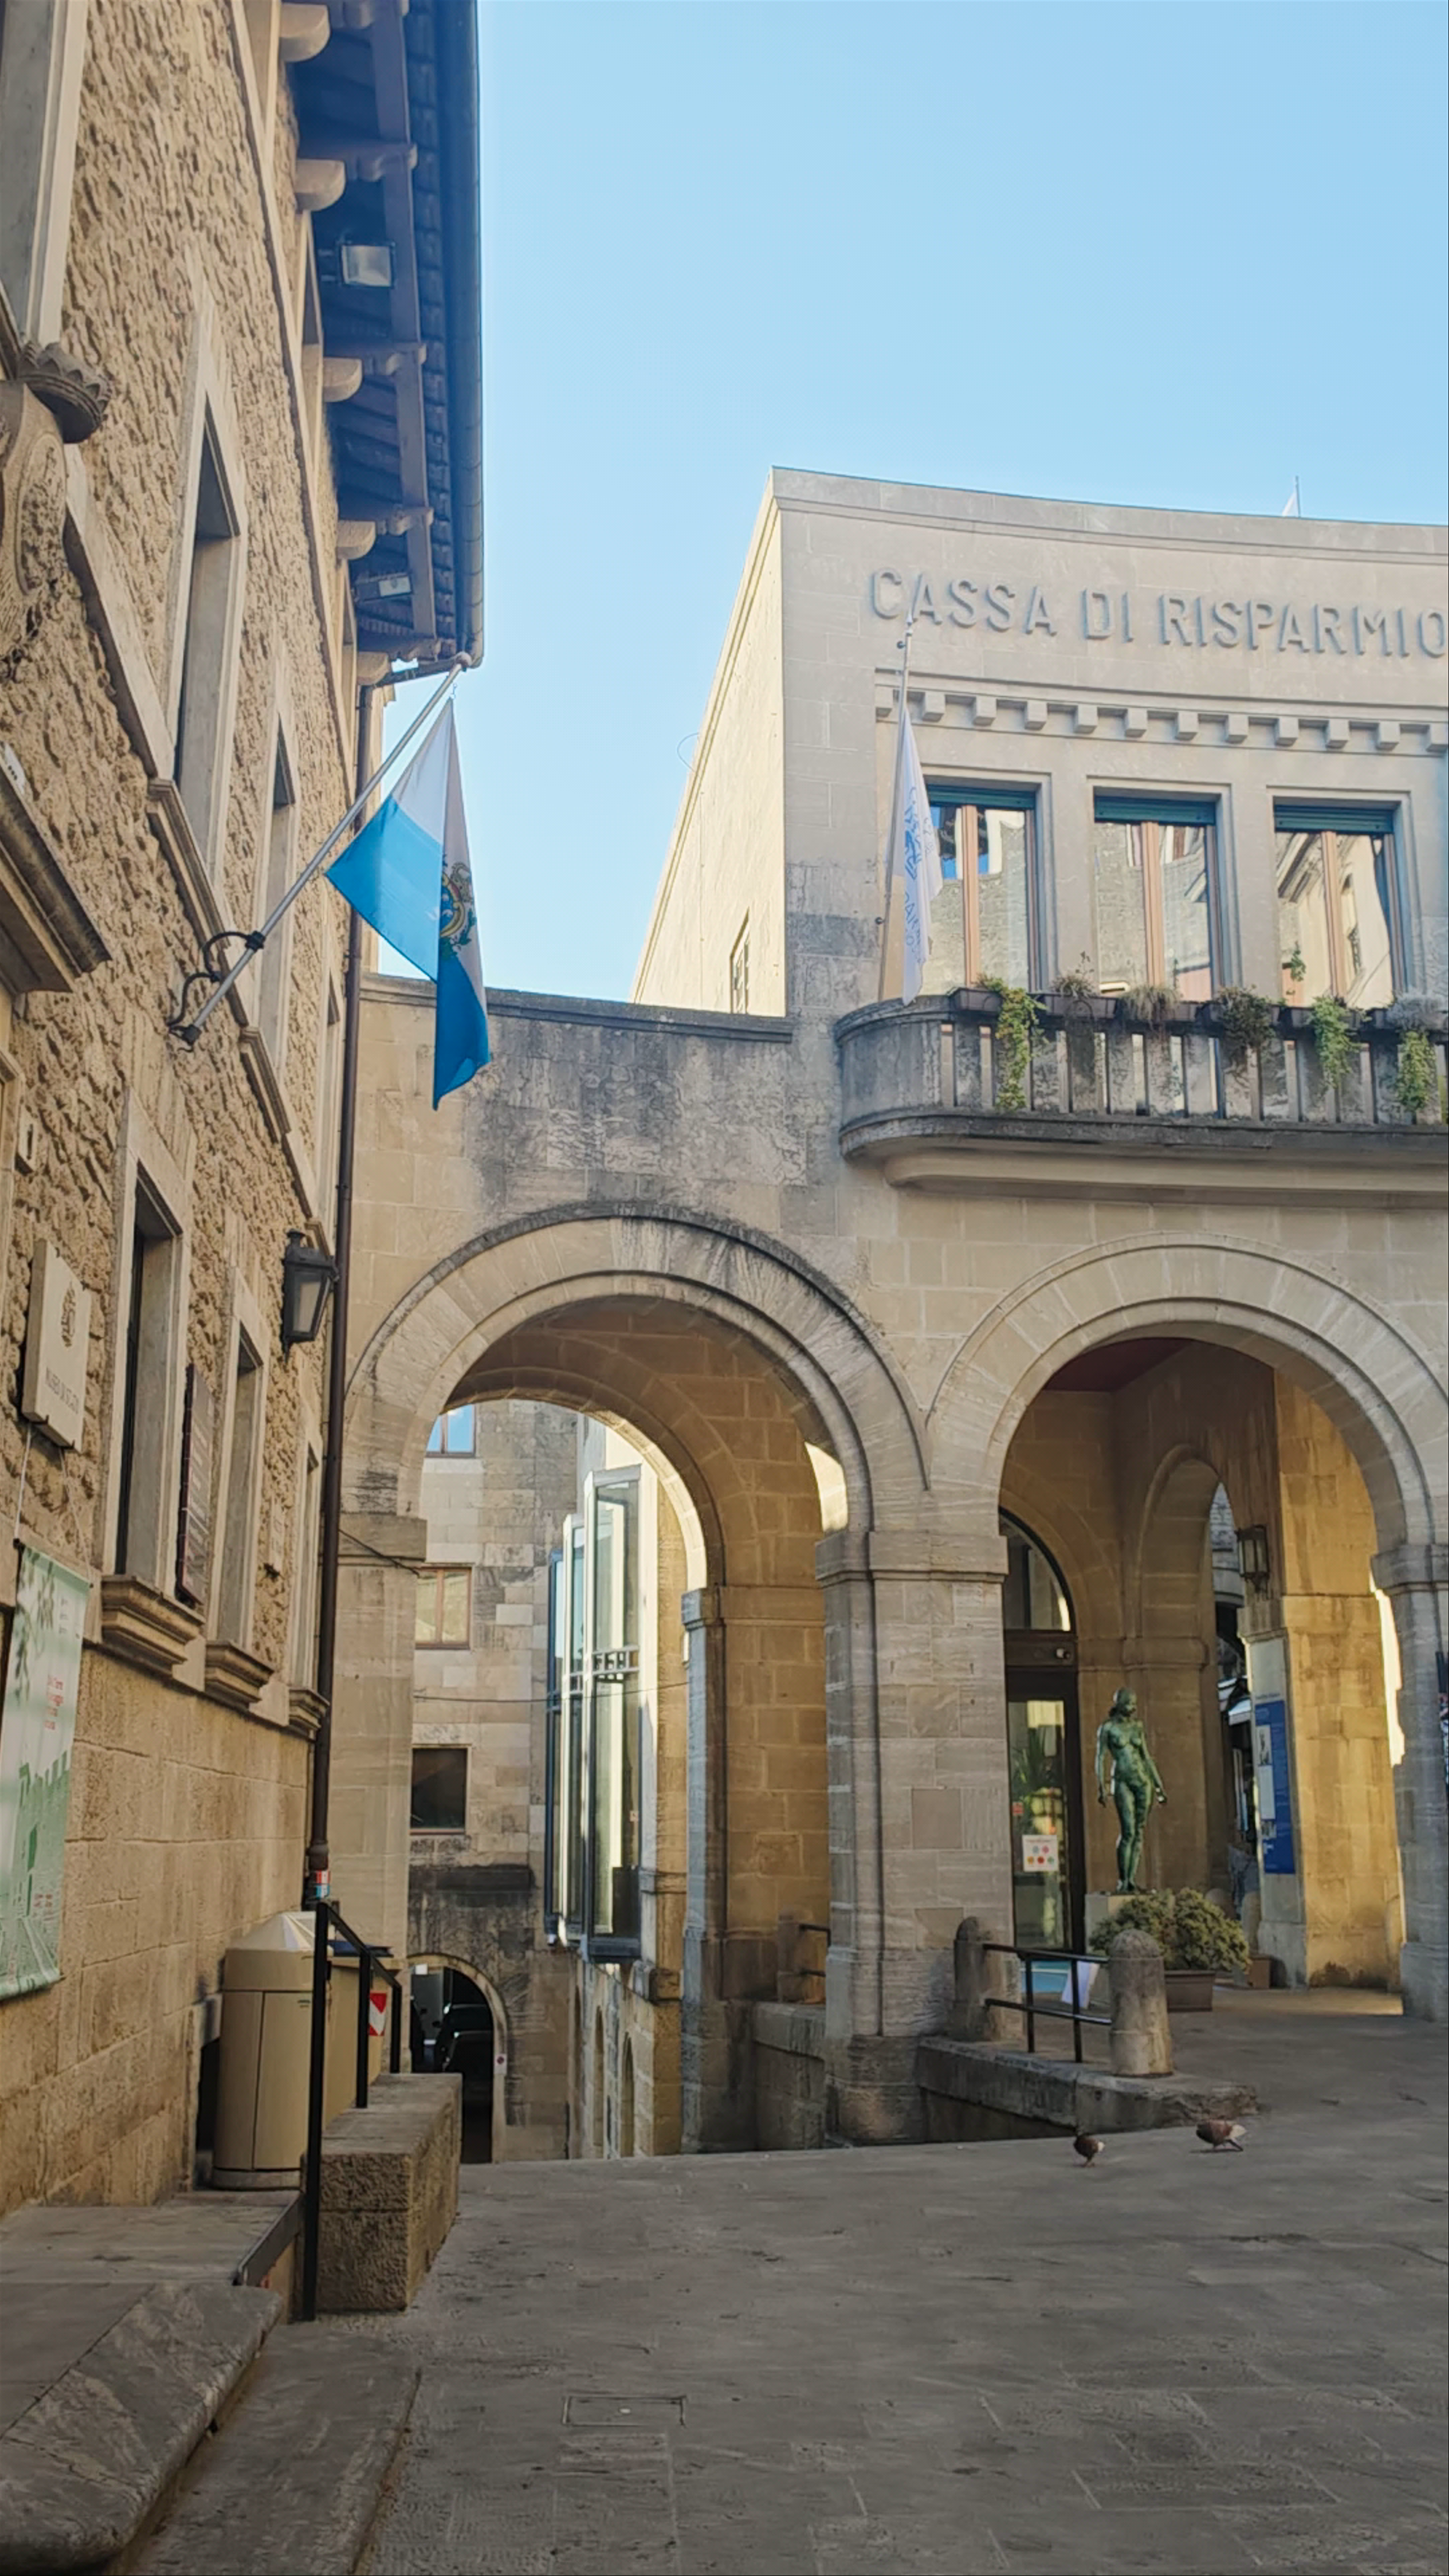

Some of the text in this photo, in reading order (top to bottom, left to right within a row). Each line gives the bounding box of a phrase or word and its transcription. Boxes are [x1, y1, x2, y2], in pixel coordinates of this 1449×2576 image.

[870, 568, 1447, 658] CASSA DI RISPARMIO
